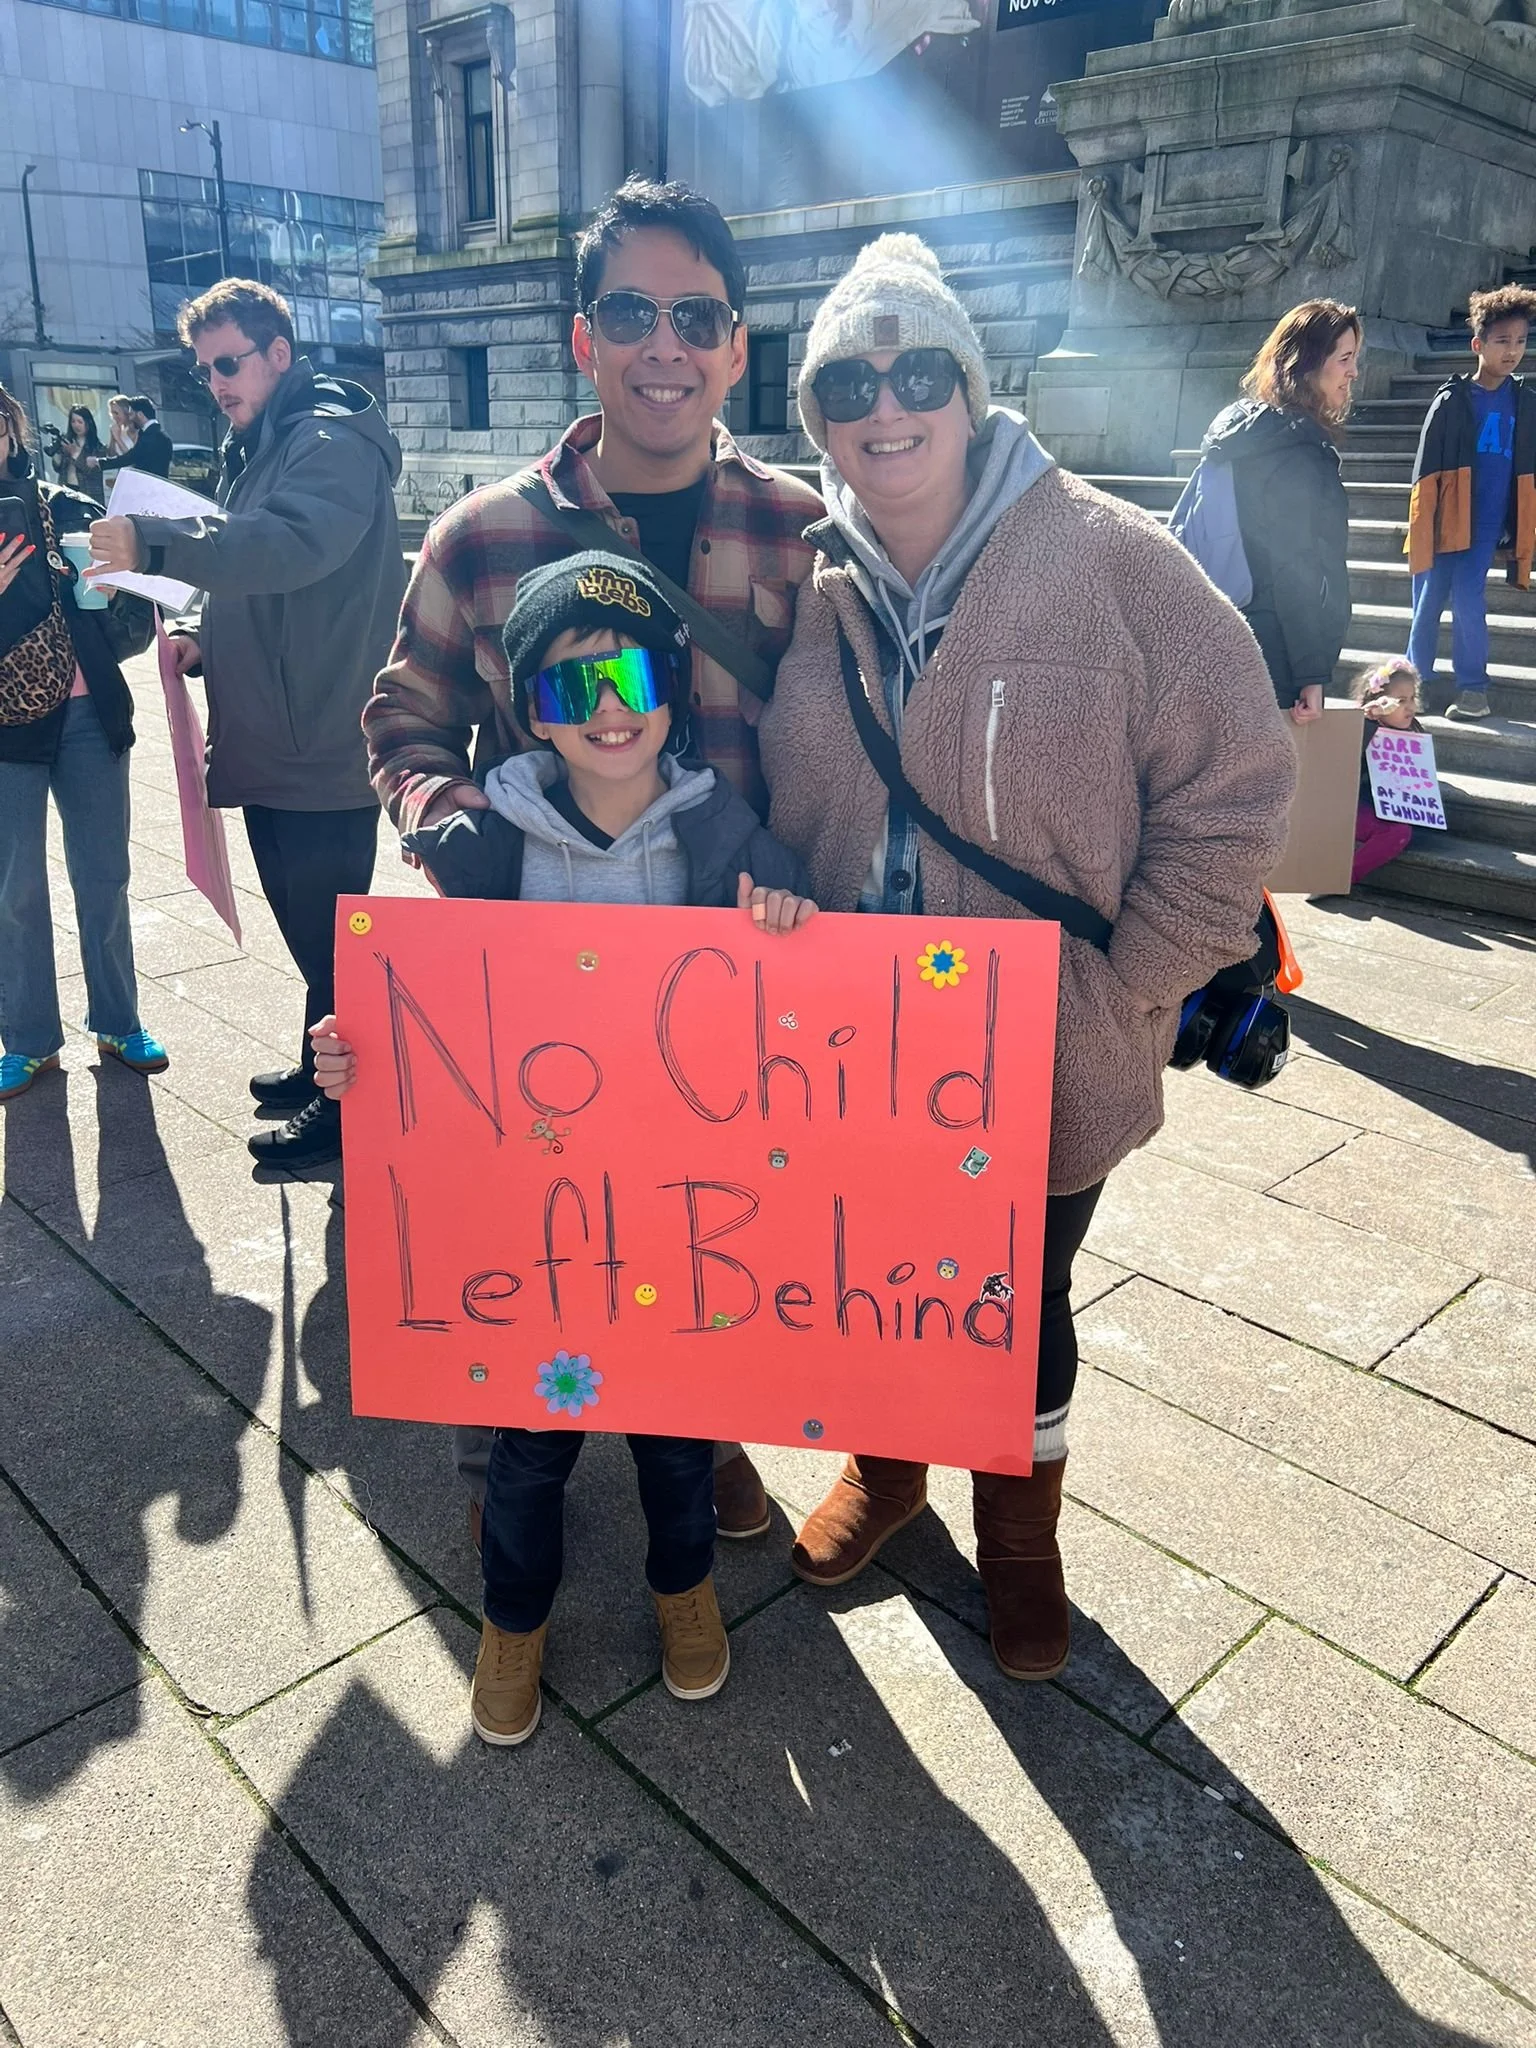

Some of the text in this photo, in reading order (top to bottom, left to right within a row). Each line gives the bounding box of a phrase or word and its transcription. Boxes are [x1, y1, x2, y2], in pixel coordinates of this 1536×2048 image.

[1379, 800, 1445, 826] FUNDING
[1402, 791, 1440, 810] FAIR
[372, 946, 1000, 1147] No Child
[388, 1163, 1016, 1354] Left Behind
